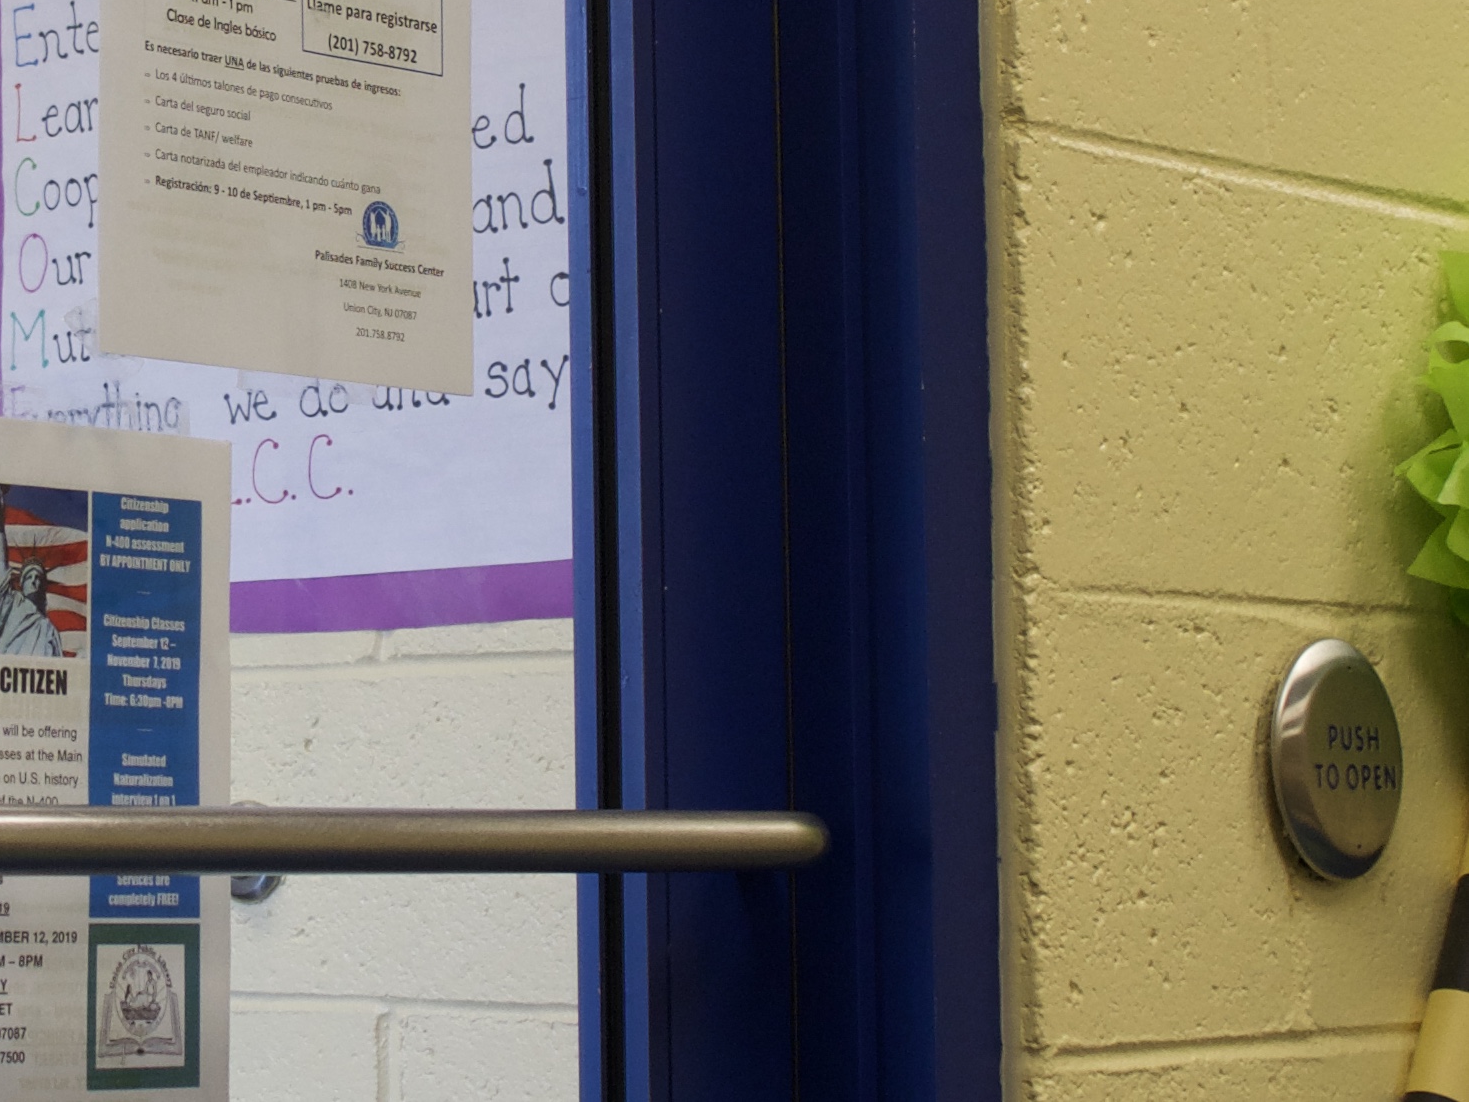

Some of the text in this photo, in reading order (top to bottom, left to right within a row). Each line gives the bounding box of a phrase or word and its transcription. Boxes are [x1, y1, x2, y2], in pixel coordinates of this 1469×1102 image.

[167, 9, 276, 42] Clase de Ingles básico
[346, 6, 372, 22] para
[376, 11, 438, 34] registrarse
[328, 33, 418, 64] (201) 758-8792
[155, 96, 251, 120] Carta del seguro social
[315, 250, 444, 277] Palisades Family Success Center
[356, 327, 405, 342] 201.758.8792
[223, 389, 276, 424] we
[100, 554, 190, 573] BY APPOINTMENT ONLY
[0, 666, 68, 695] CITIZEN
[3, 725, 19, 736] will
[22, 726, 34, 737] be
[38, 727, 77, 741] offering
[1328, 725, 1380, 751] PUSH
[1315, 763, 1397, 790] TO OPEN
[33, 932, 48, 945] 12,
[52, 932, 78, 943] 2019
